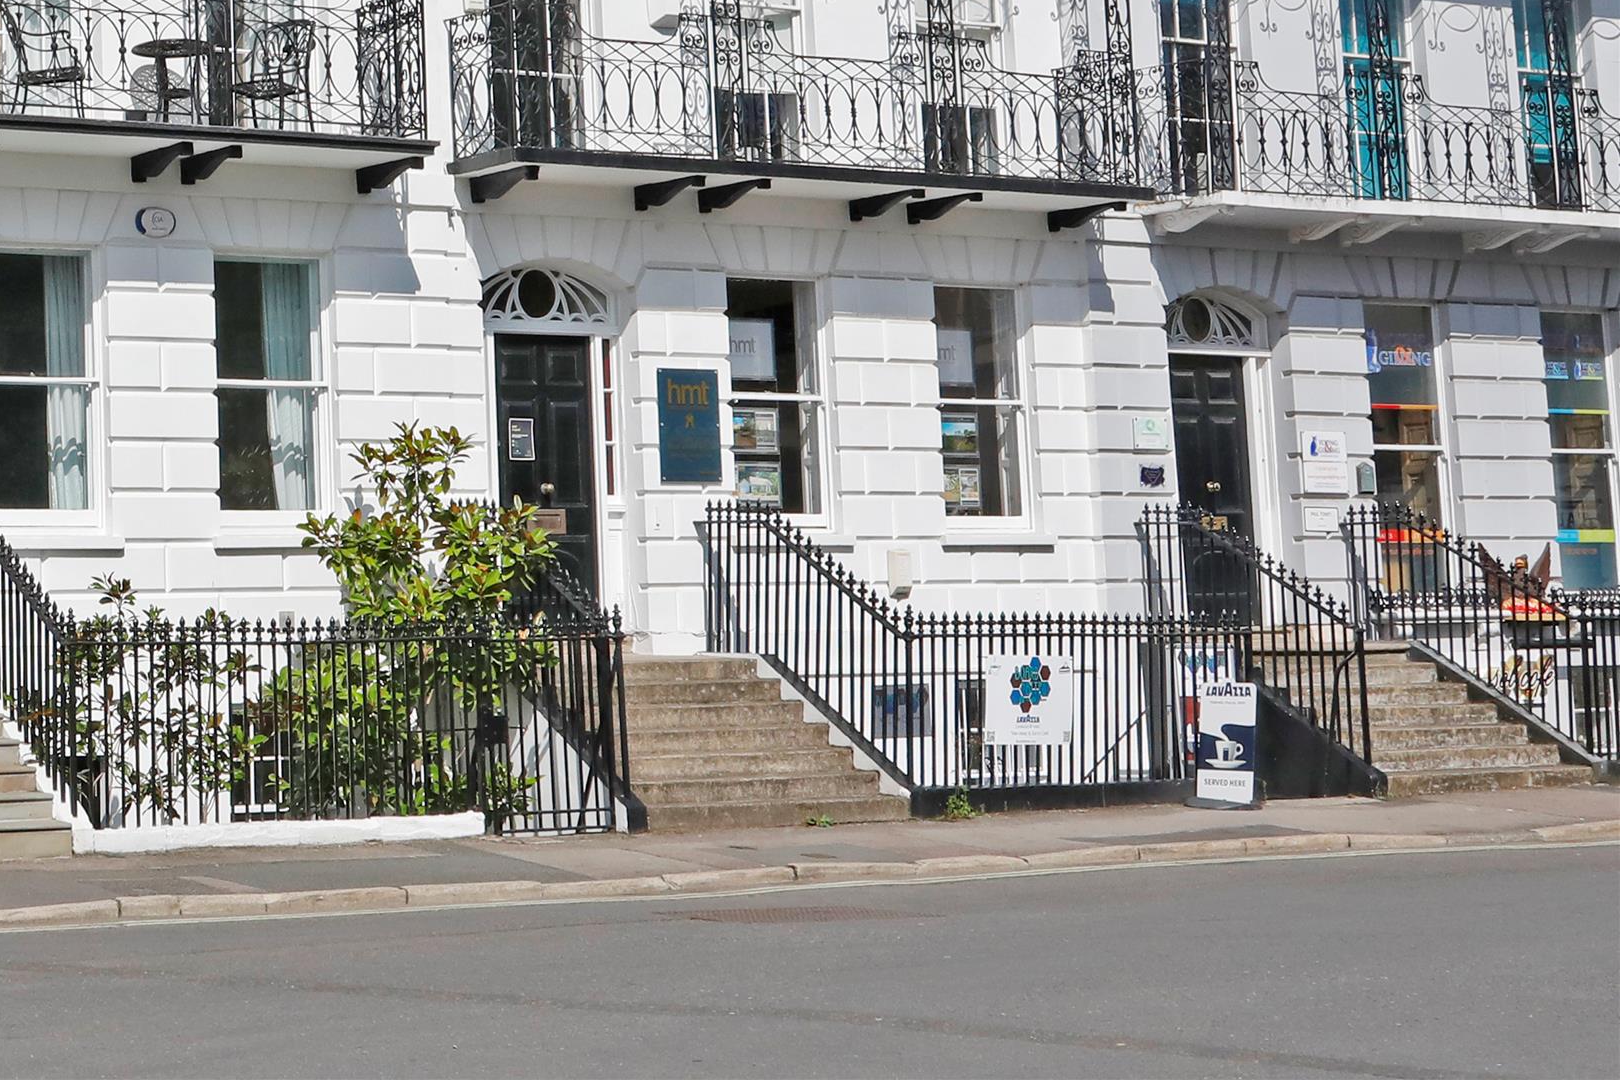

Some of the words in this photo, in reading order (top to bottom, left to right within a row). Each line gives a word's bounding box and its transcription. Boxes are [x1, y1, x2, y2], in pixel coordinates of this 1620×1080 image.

[938, 344, 956, 361] mt
[667, 378, 709, 406] hmt
[1206, 682, 1252, 697] LAVAZZA
[1203, 778, 1229, 787] SERVED
[1229, 779, 1246, 787] HERE
